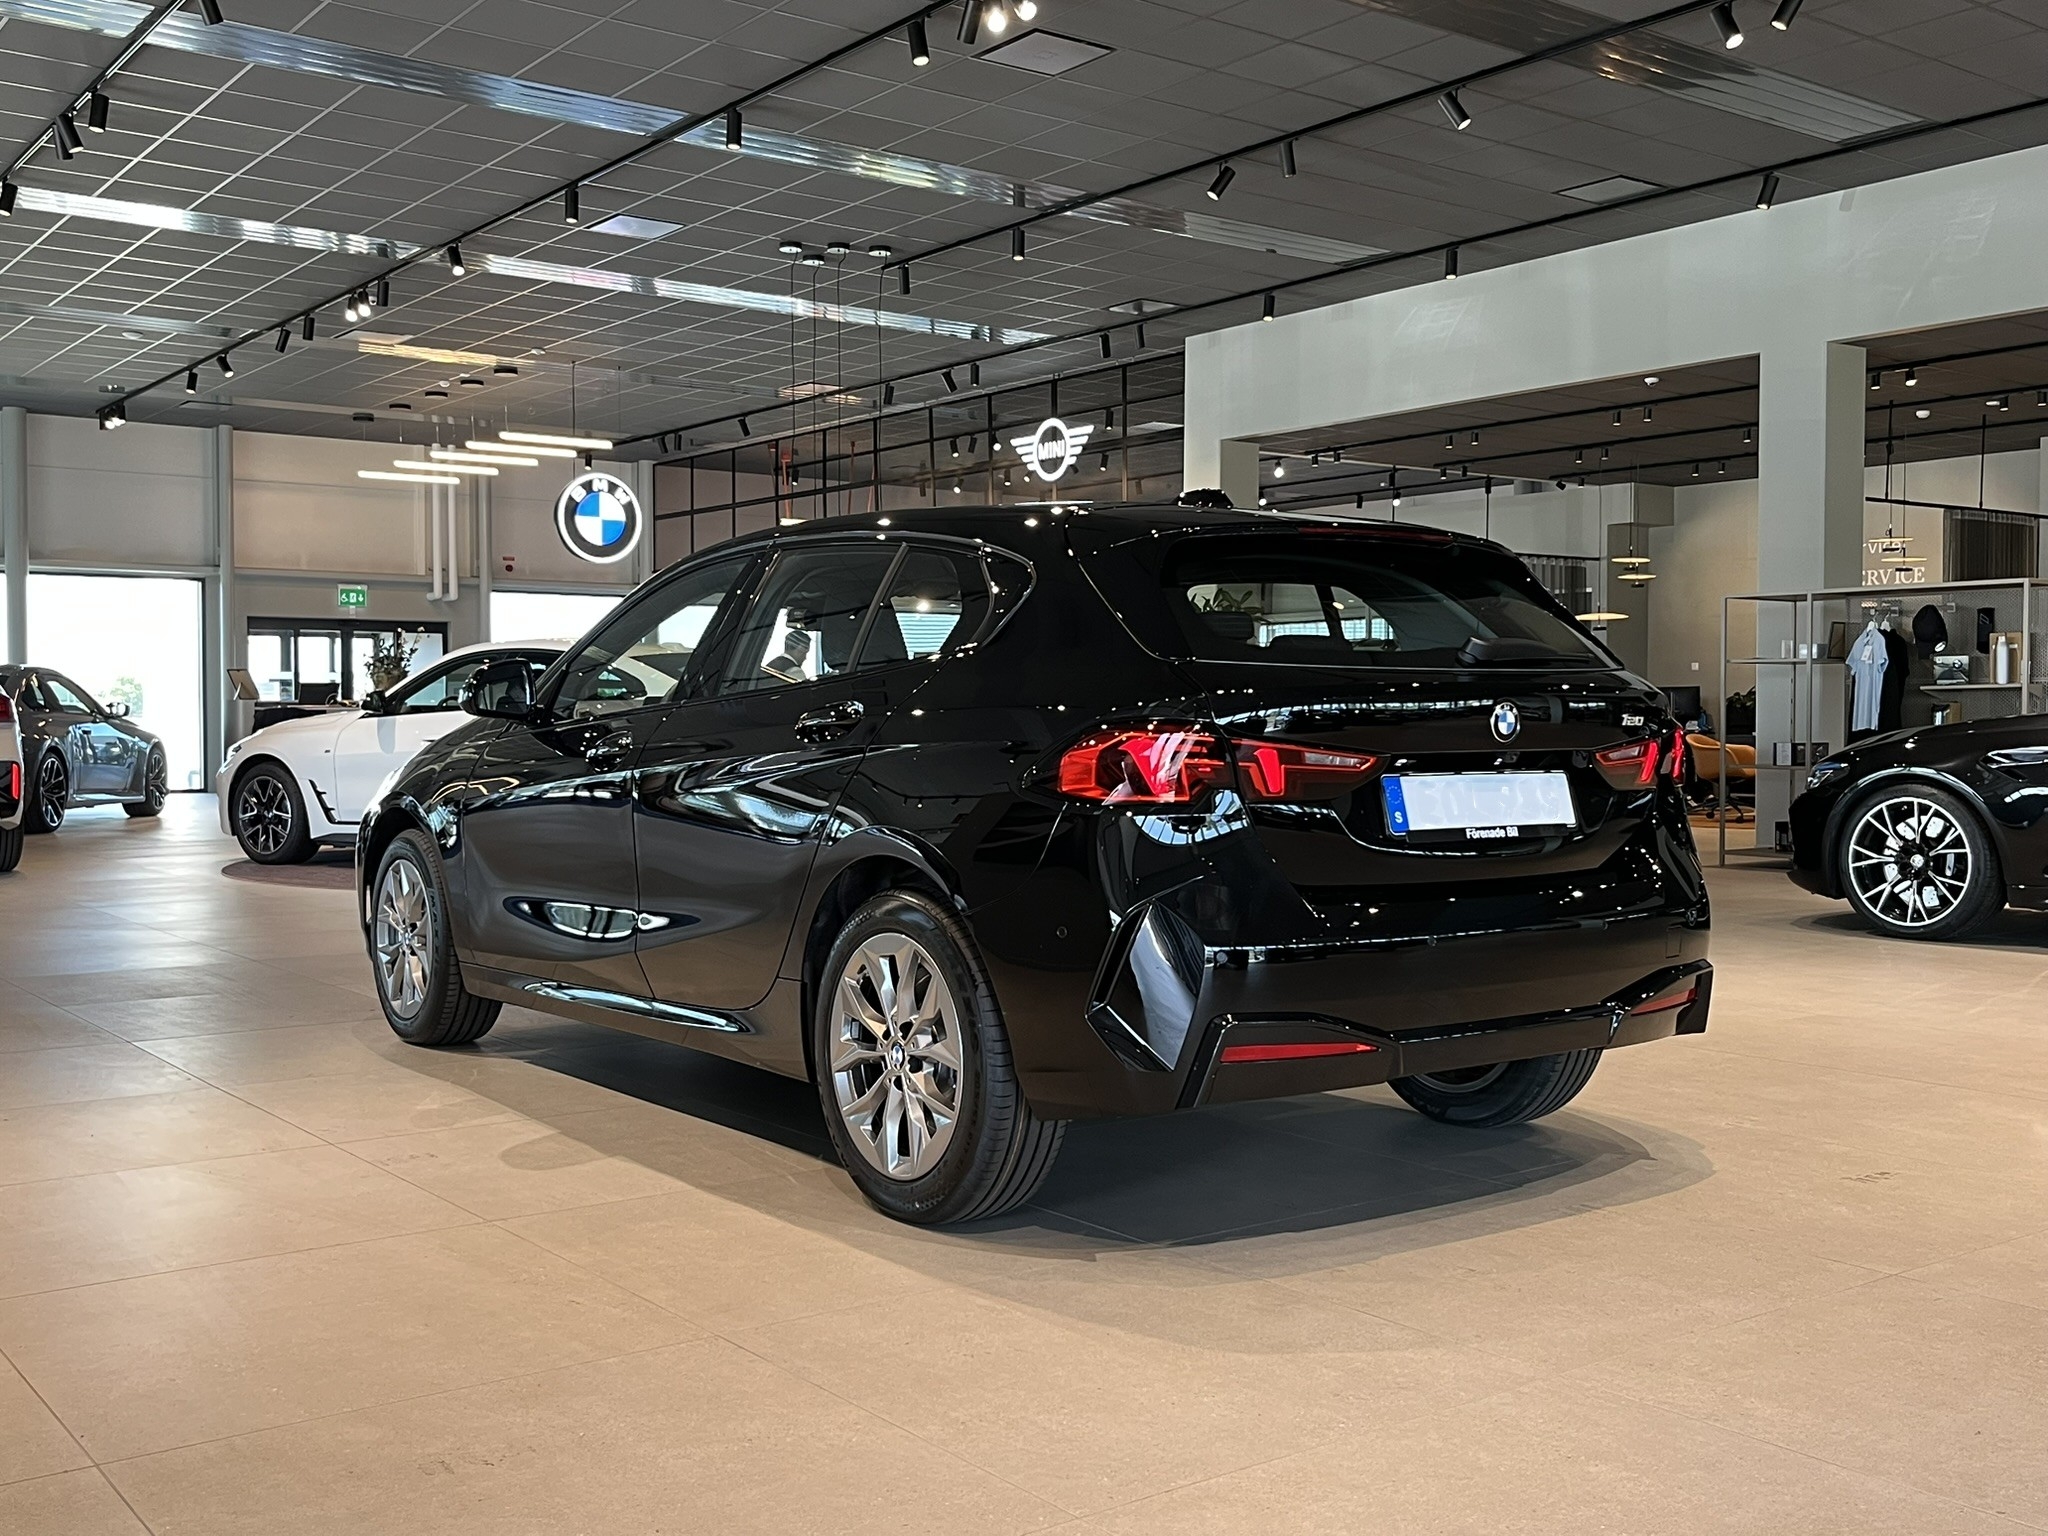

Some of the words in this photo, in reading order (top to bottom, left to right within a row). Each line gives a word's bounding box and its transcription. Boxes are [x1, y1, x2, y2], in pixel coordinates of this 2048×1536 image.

[1038, 439, 1066, 461] MINI
[570, 478, 631, 505] BMW
[1394, 811, 1403, 824] S
